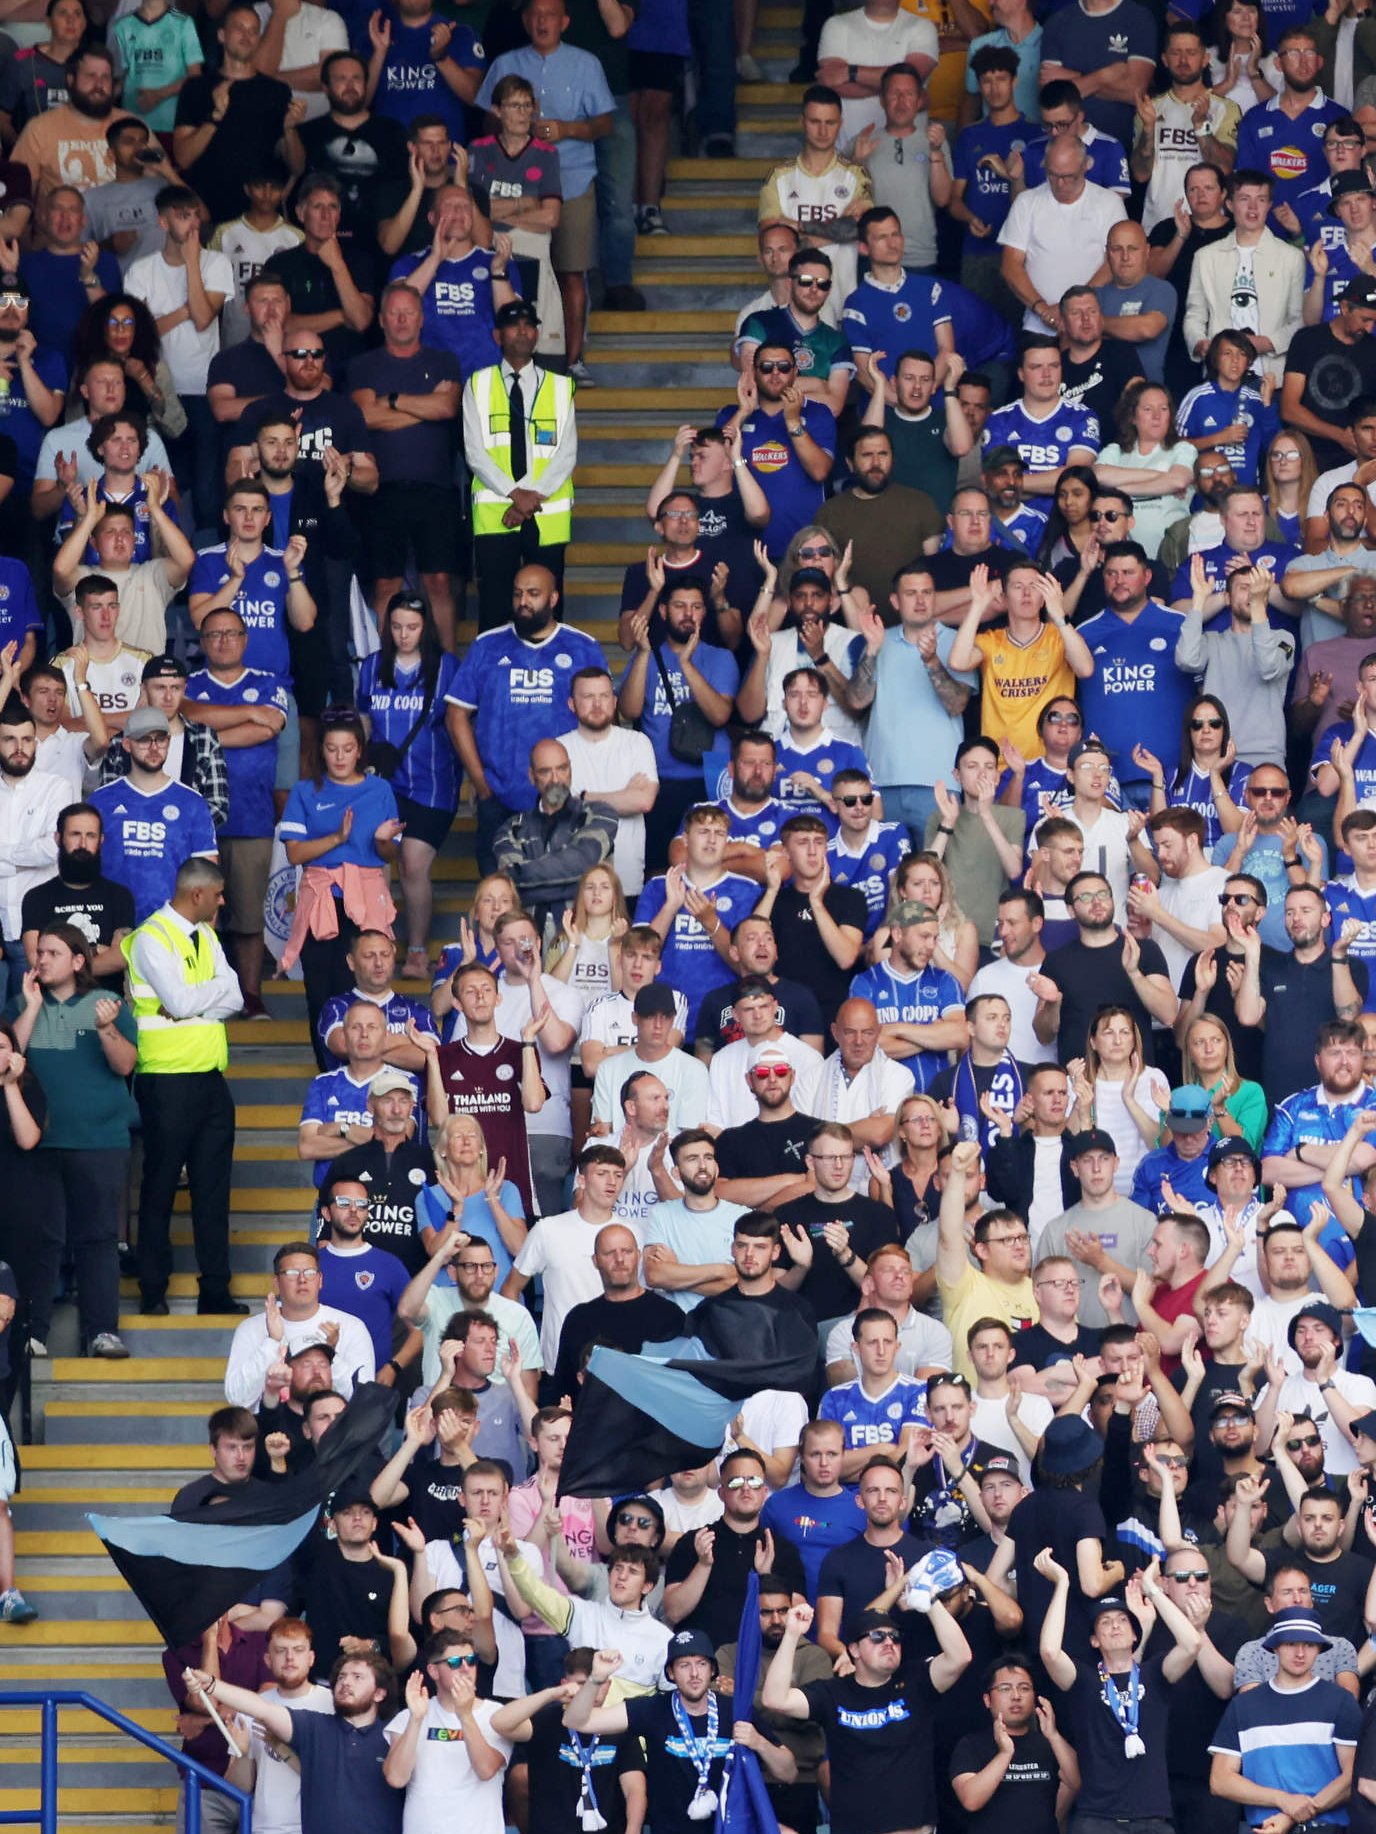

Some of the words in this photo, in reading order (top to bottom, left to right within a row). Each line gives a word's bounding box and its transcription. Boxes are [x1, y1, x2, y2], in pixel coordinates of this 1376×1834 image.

[387, 64, 436, 80] KING
[387, 79, 435, 90] POWER
[1159, 128, 1198, 146] FBS
[1270, 154, 1307, 170] WALKERS
[490, 180, 522, 198] FBS
[798, 204, 837, 224] FBS
[1320, 227, 1347, 244] FB
[239, 262, 265, 276] FB
[435, 282, 474, 300] FBS
[751, 449, 788, 466] WALKERS
[1018, 446, 1059, 463] FBS
[1103, 664, 1156, 682] KING
[994, 677, 1048, 690] WALKERS
[1104, 679, 1155, 694] POWER
[1001, 687, 1043, 698] CRISPS
[94, 694, 128, 708] BS
[123, 820, 166, 839] FBS
[55, 904, 83, 913] SCREW
[86, 904, 104, 912] YOU
[575, 963, 609, 977] FBS
[453, 1093, 511, 1106] THAILAND
[479, 1104, 495, 1113] WITH
[496, 1104, 511, 1113] YOU
[851, 1424, 894, 1444] FBS
[841, 1710, 887, 1727] UNION
